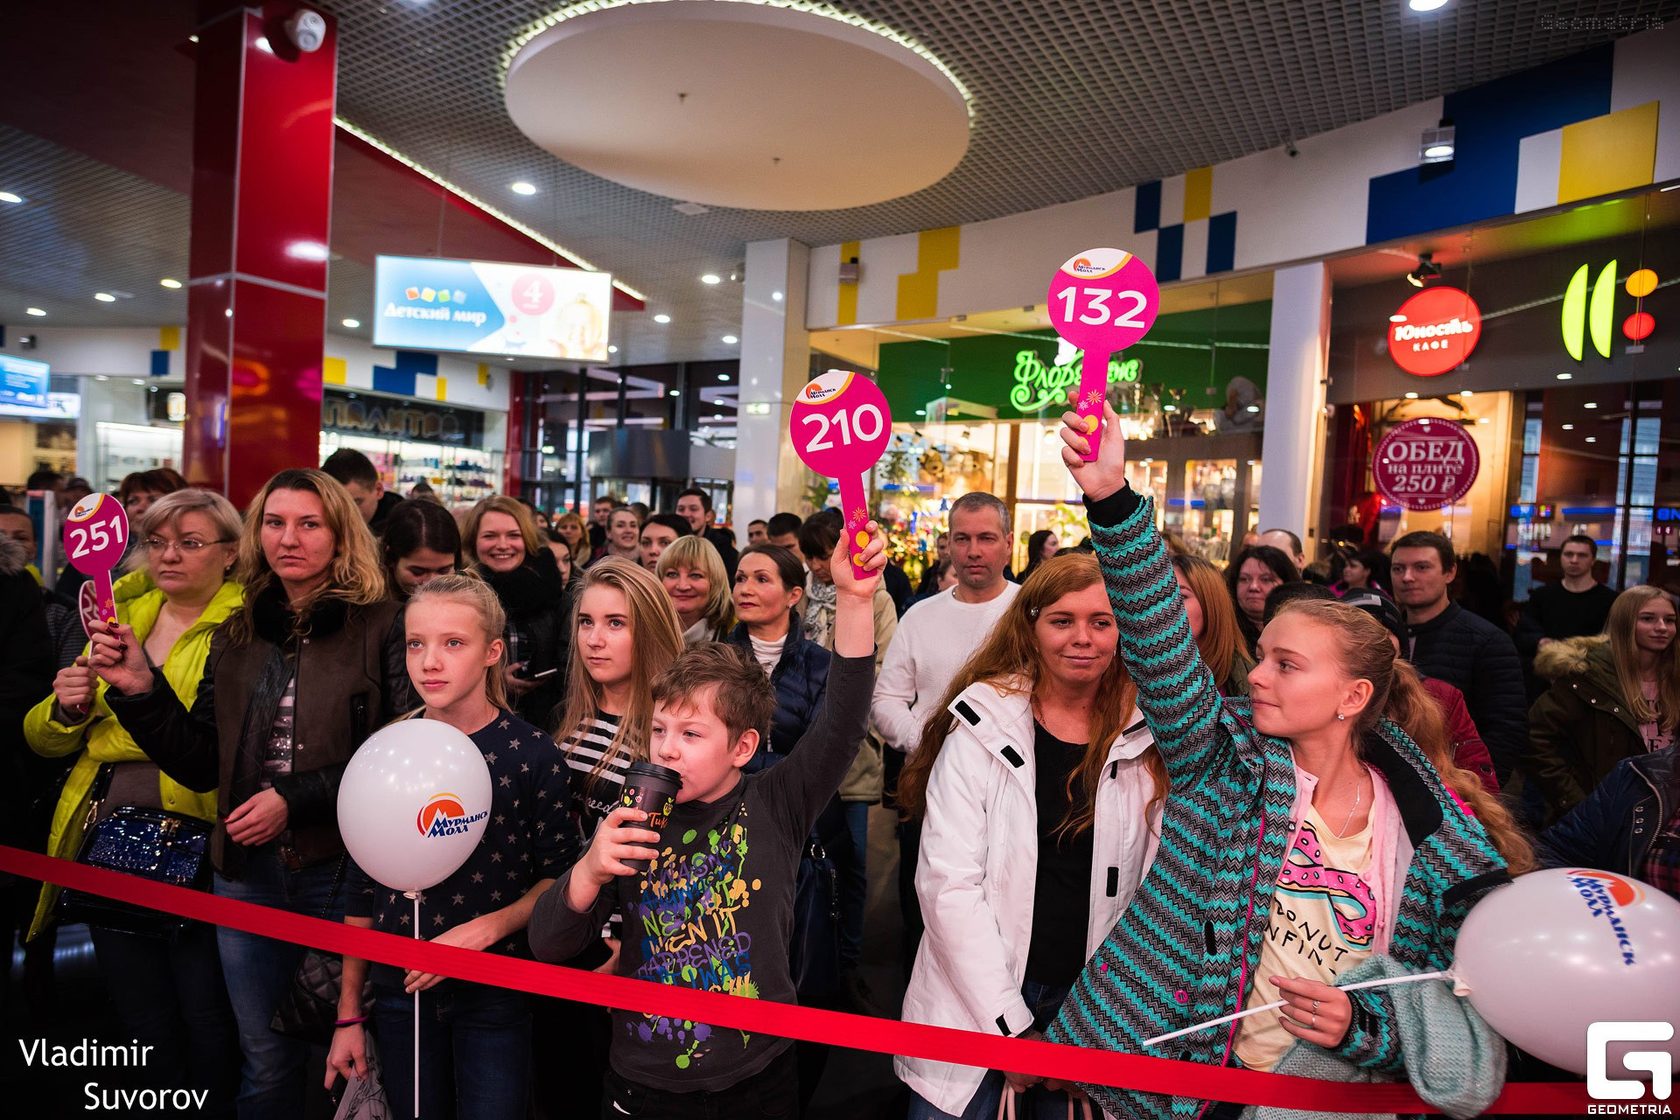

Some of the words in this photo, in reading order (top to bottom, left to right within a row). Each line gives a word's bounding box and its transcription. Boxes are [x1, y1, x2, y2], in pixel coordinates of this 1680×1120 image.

[1057, 286, 1147, 329] 132
[801, 403, 884, 453] 210
[1387, 440, 1465, 465] ОБЕД
[1387, 463, 1408, 475] на
[1392, 475, 1437, 493] 250
[70, 515, 123, 559] 251
